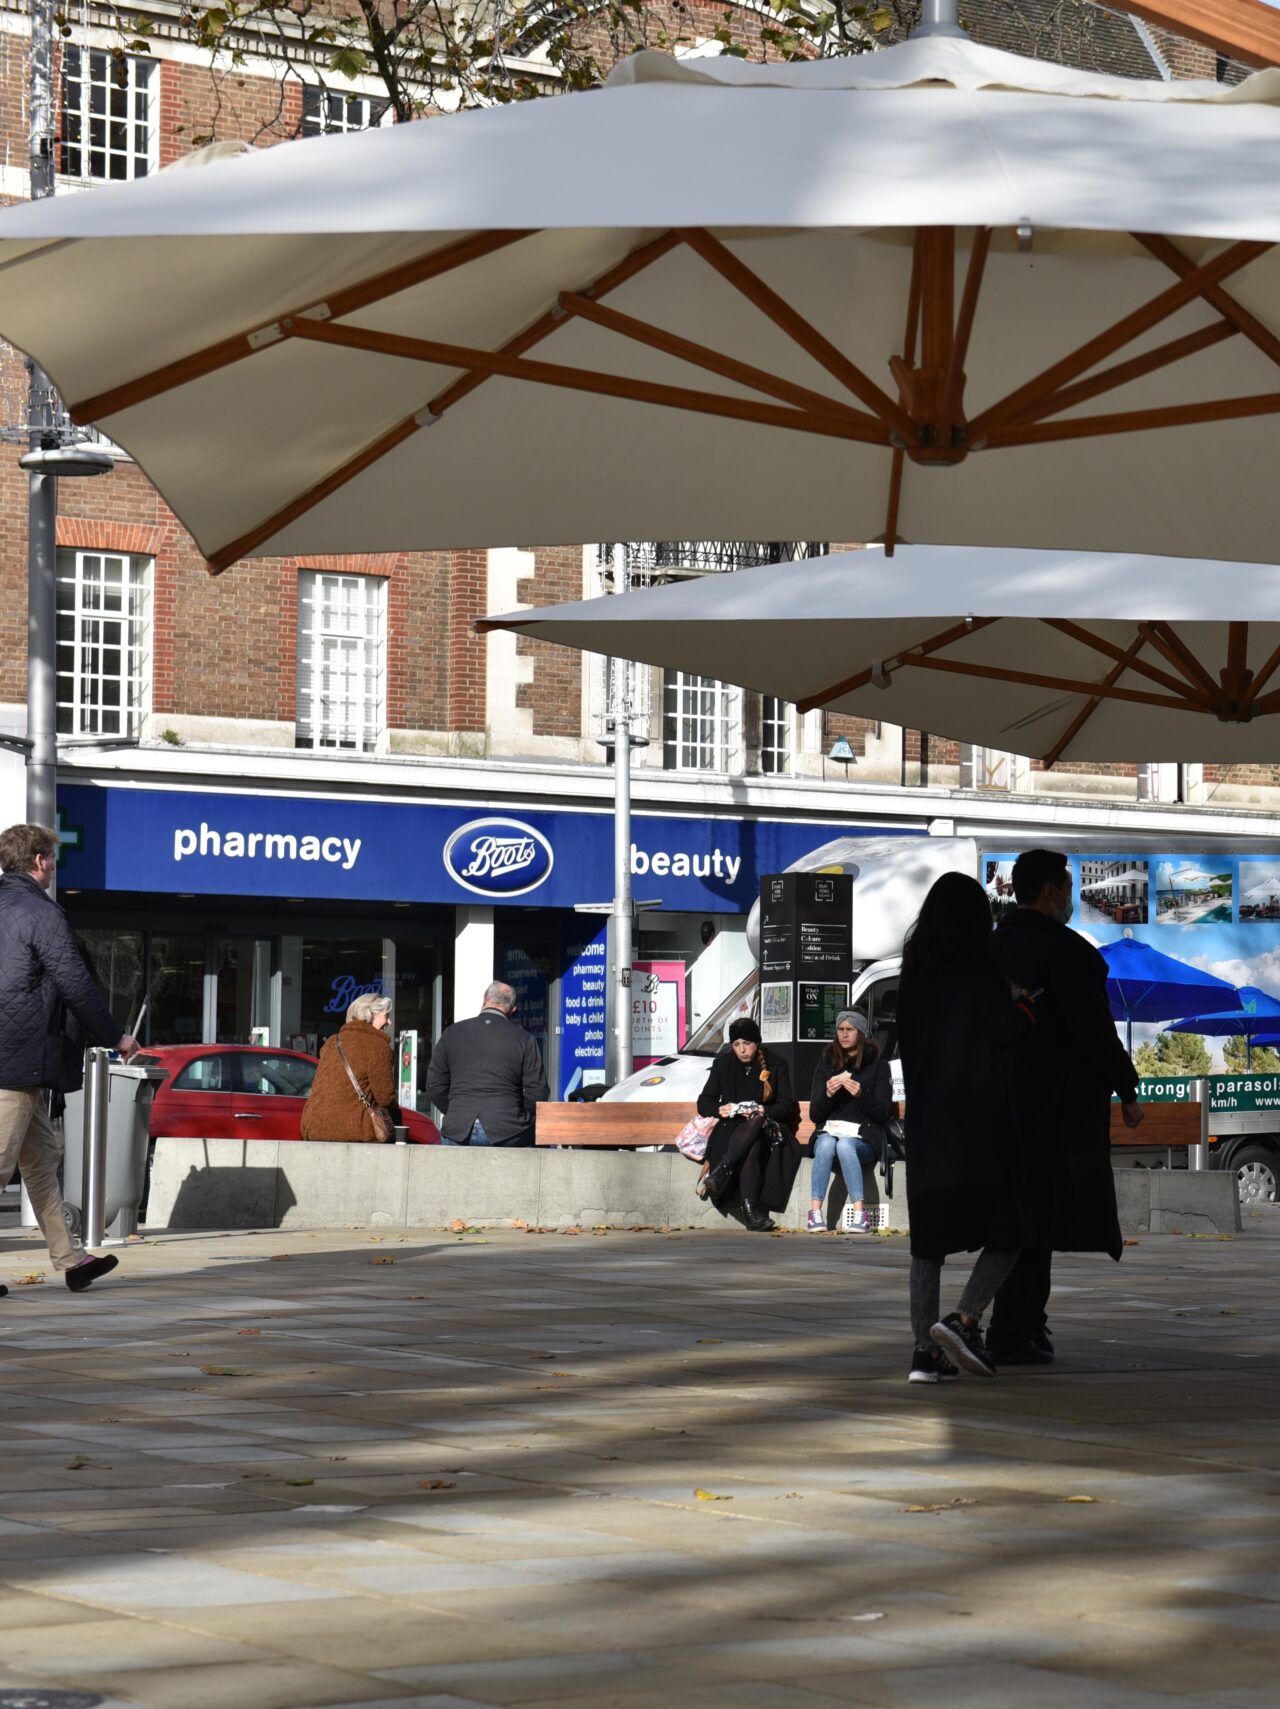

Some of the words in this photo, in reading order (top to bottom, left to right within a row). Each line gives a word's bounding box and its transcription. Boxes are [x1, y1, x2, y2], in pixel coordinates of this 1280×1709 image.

[174, 822, 362, 870] pharmacy
[461, 836, 536, 878] Boots
[630, 843, 741, 885] beauty
[801, 926, 819, 934] Beauty
[573, 962, 604, 977] pharmacy
[582, 980, 604, 992] beauty
[565, 997, 581, 1008] food
[581, 996, 587, 1007] &
[587, 995, 604, 1007] drink
[632, 1000, 657, 1014] £10
[565, 1014, 581, 1026] baby
[582, 1014, 588, 1024] &
[588, 1012, 604, 1024] child
[584, 1029, 604, 1042] photo
[633, 1025, 662, 1033] OINTS
[575, 1046, 604, 1057] electrical
[1210, 1097, 1238, 1108] km/h
